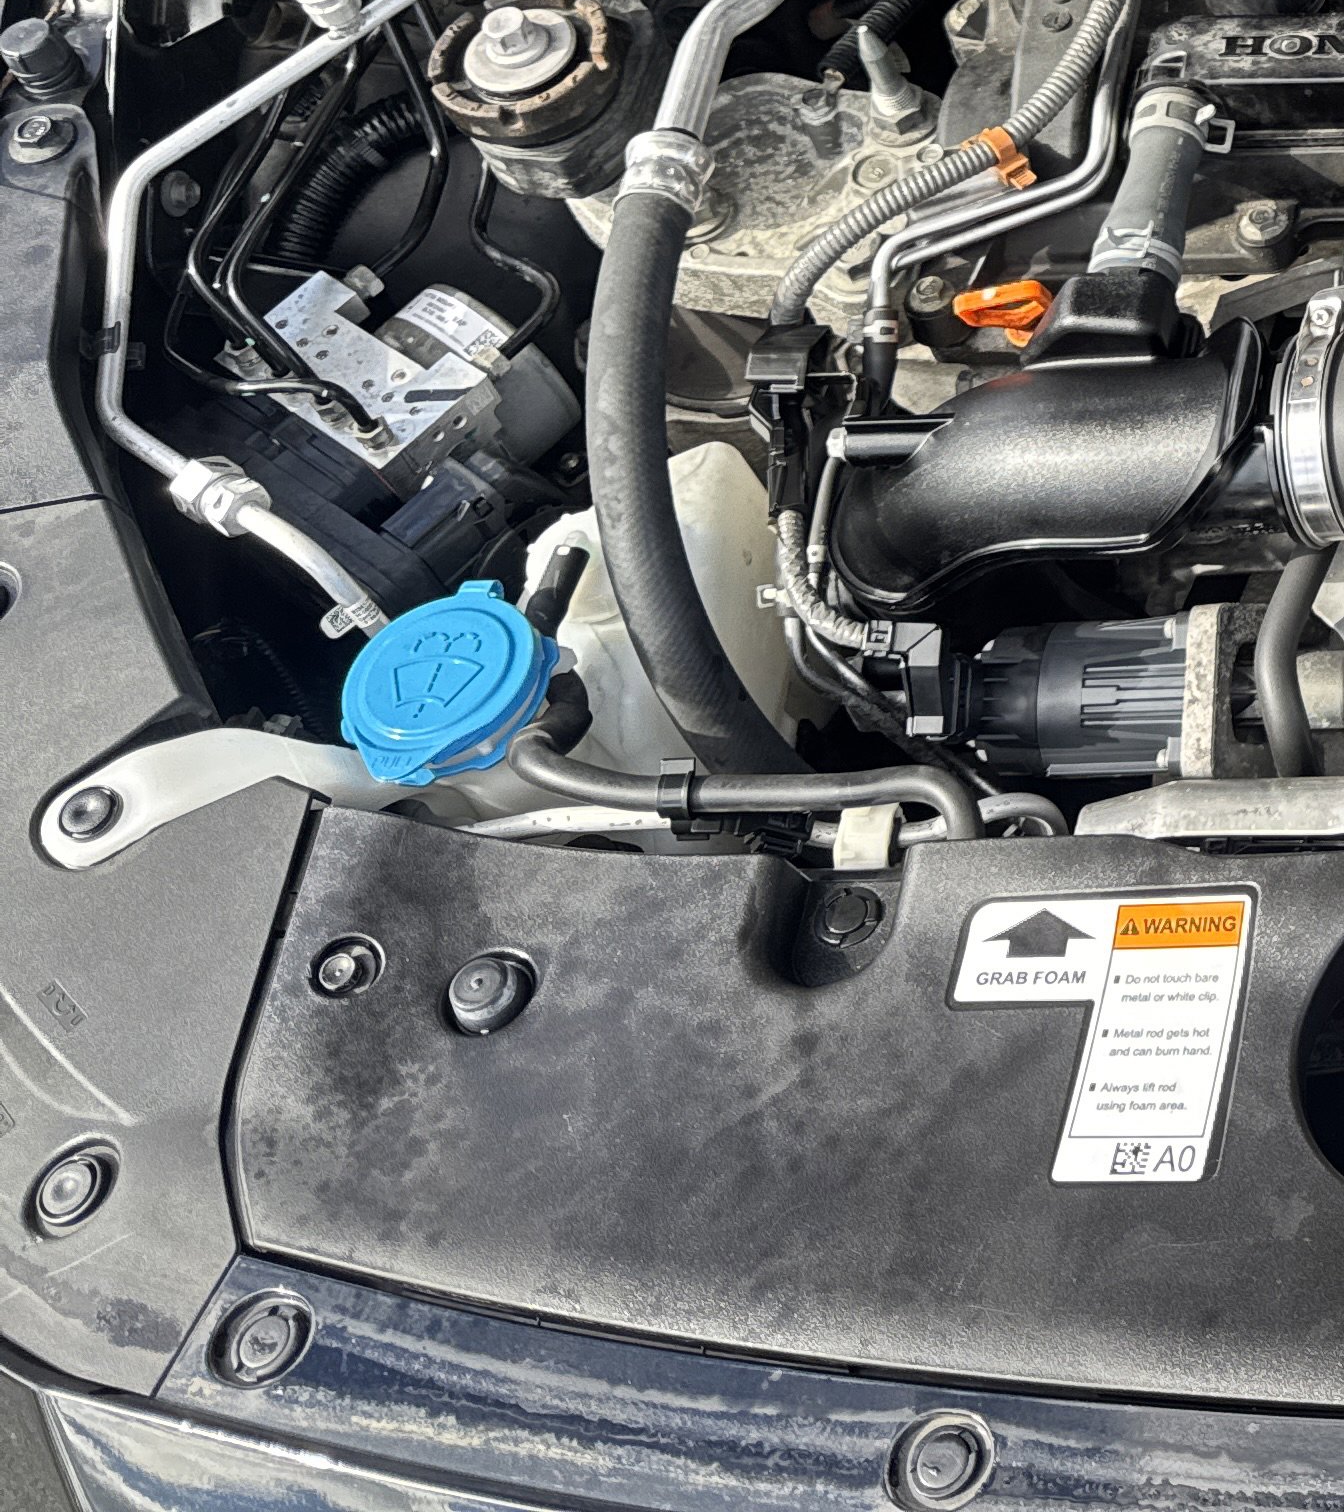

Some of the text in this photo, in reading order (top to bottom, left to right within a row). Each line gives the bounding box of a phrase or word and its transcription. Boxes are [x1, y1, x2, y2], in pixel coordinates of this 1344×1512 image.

[1144, 916, 1237, 934] WARNING
[976, 971, 1086, 985] GRAB FOAM
[1125, 973, 1219, 984] Do not touch bare
[1121, 992, 1219, 1004] metal or white clip.
[1113, 1028, 1210, 1040] Metal rod gets hot
[1109, 1046, 1212, 1056] and can burn hand.
[1100, 1082, 1176, 1094] Always lift rod
[1096, 1100, 1187, 1113] using foam area.
[1153, 1145, 1196, 1172] A0
